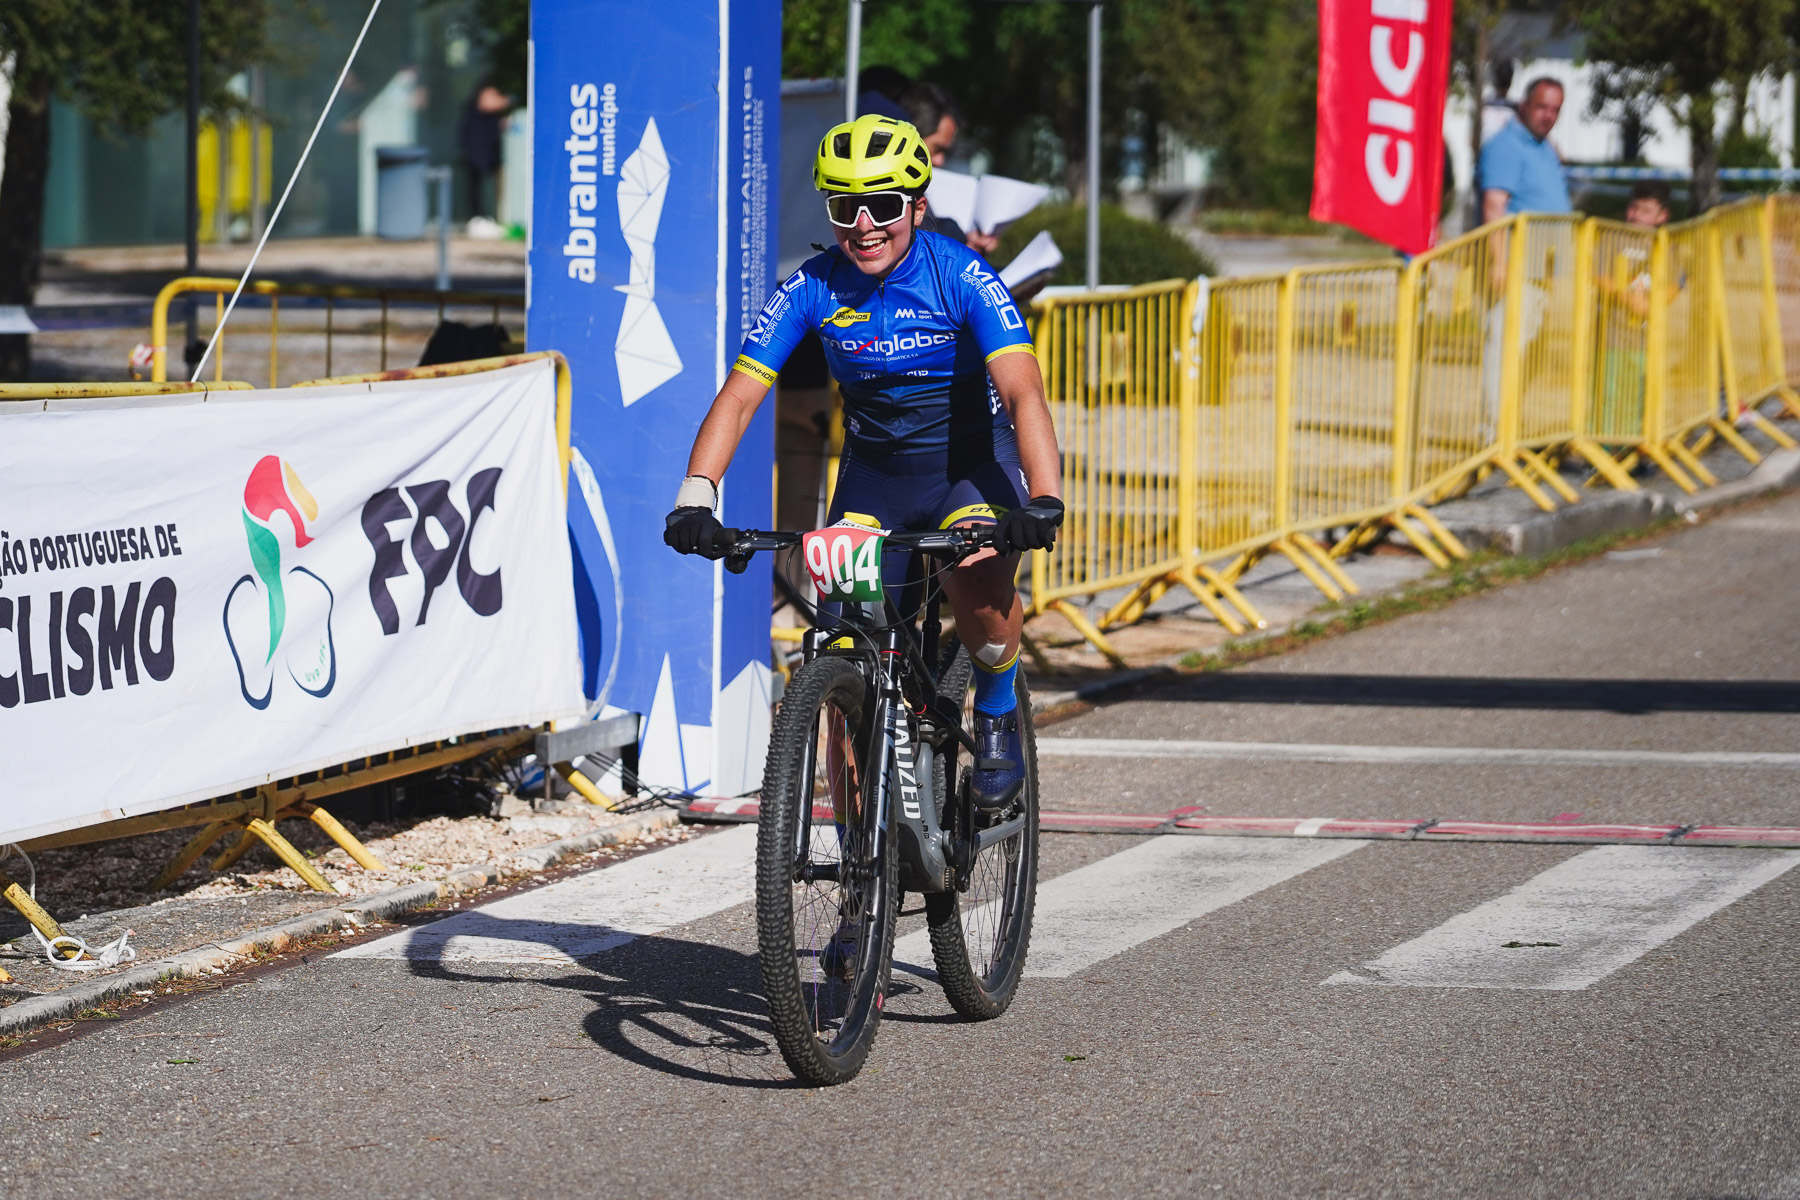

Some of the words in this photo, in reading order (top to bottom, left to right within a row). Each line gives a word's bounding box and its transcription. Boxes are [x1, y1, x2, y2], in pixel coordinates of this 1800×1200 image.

[562, 82, 599, 285] abrantes
[747, 269, 806, 343] MBO
[965, 259, 1023, 330] MBO
[0, 530, 27, 584] ÃO
[29, 526, 154, 573] PORTUGUESA
[154, 523, 182, 561] DE
[360, 467, 503, 636] FPC
[806, 534, 879, 595] 904
